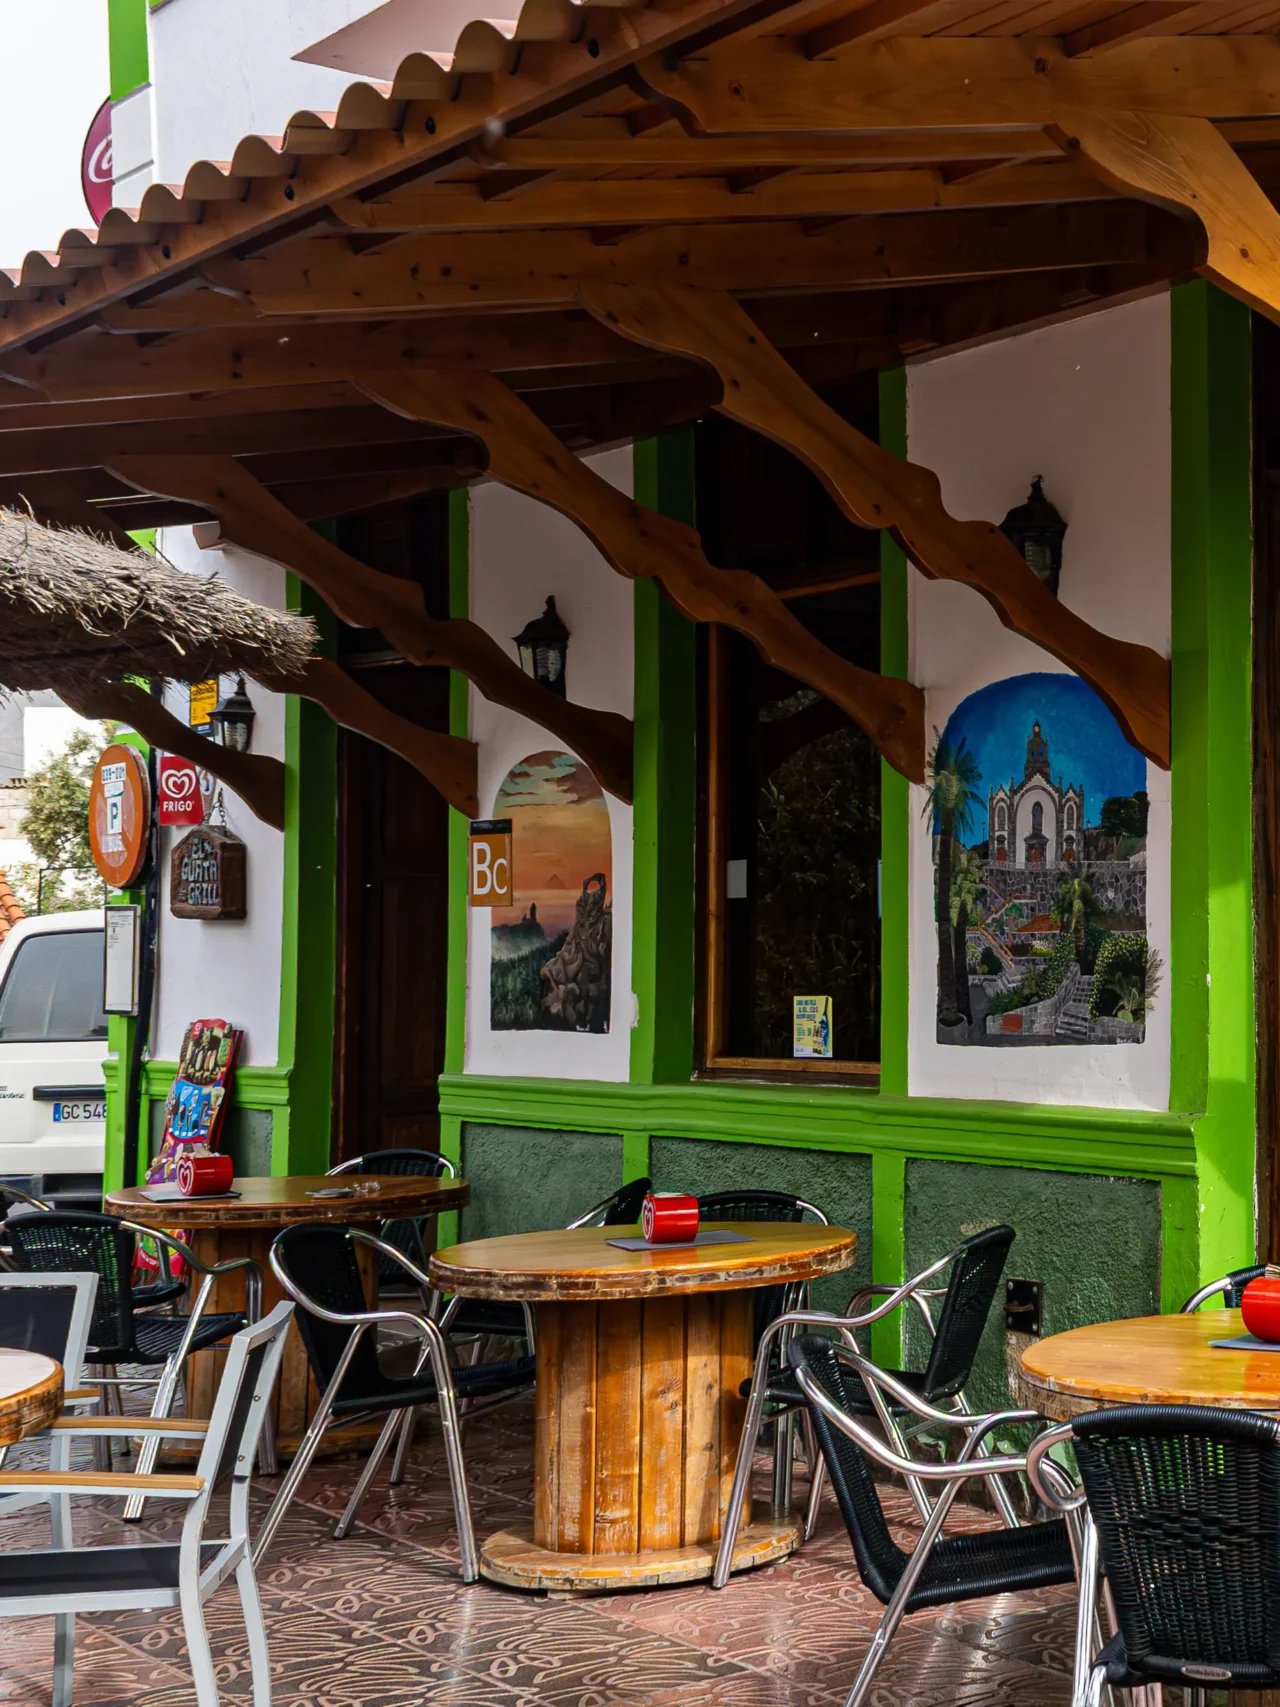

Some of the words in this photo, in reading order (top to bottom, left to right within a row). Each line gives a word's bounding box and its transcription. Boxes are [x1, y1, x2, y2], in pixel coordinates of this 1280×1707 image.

[163, 801, 193, 812] FRIGO
[473, 842, 507, 895] Bc
[61, 1104, 80, 1120] GC
